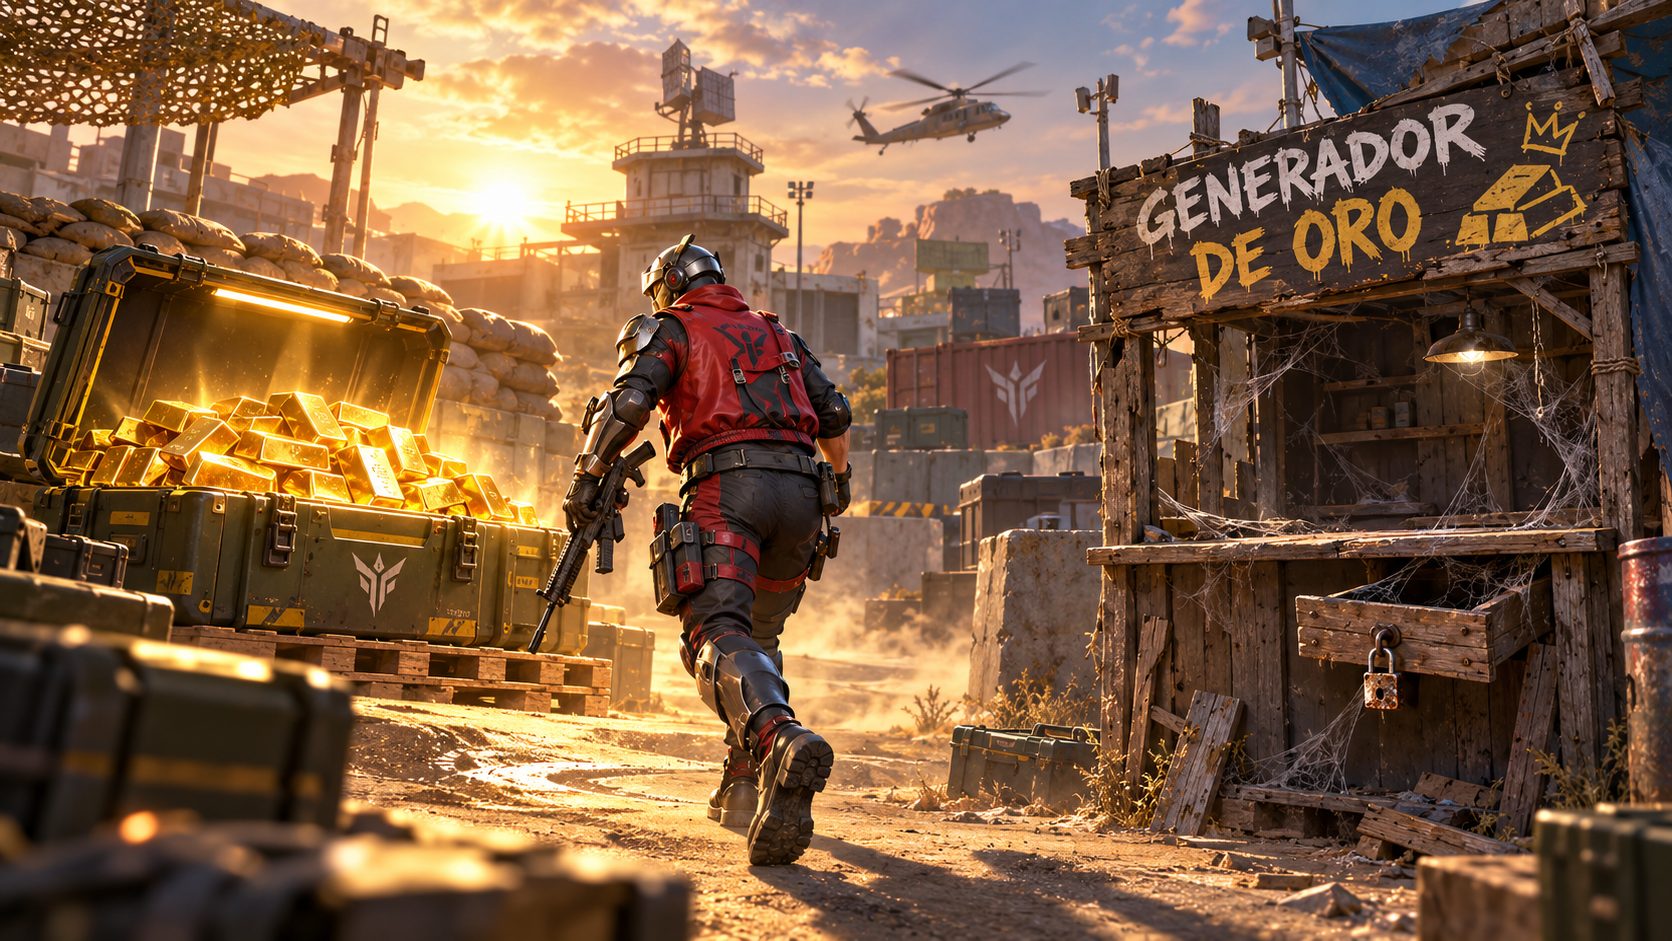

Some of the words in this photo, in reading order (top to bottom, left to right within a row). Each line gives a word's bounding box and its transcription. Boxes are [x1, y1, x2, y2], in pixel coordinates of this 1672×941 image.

[1136, 103, 1487, 261] GENERADOR
[1190, 226, 1273, 305] DE
[1292, 187, 1423, 282] ORO
